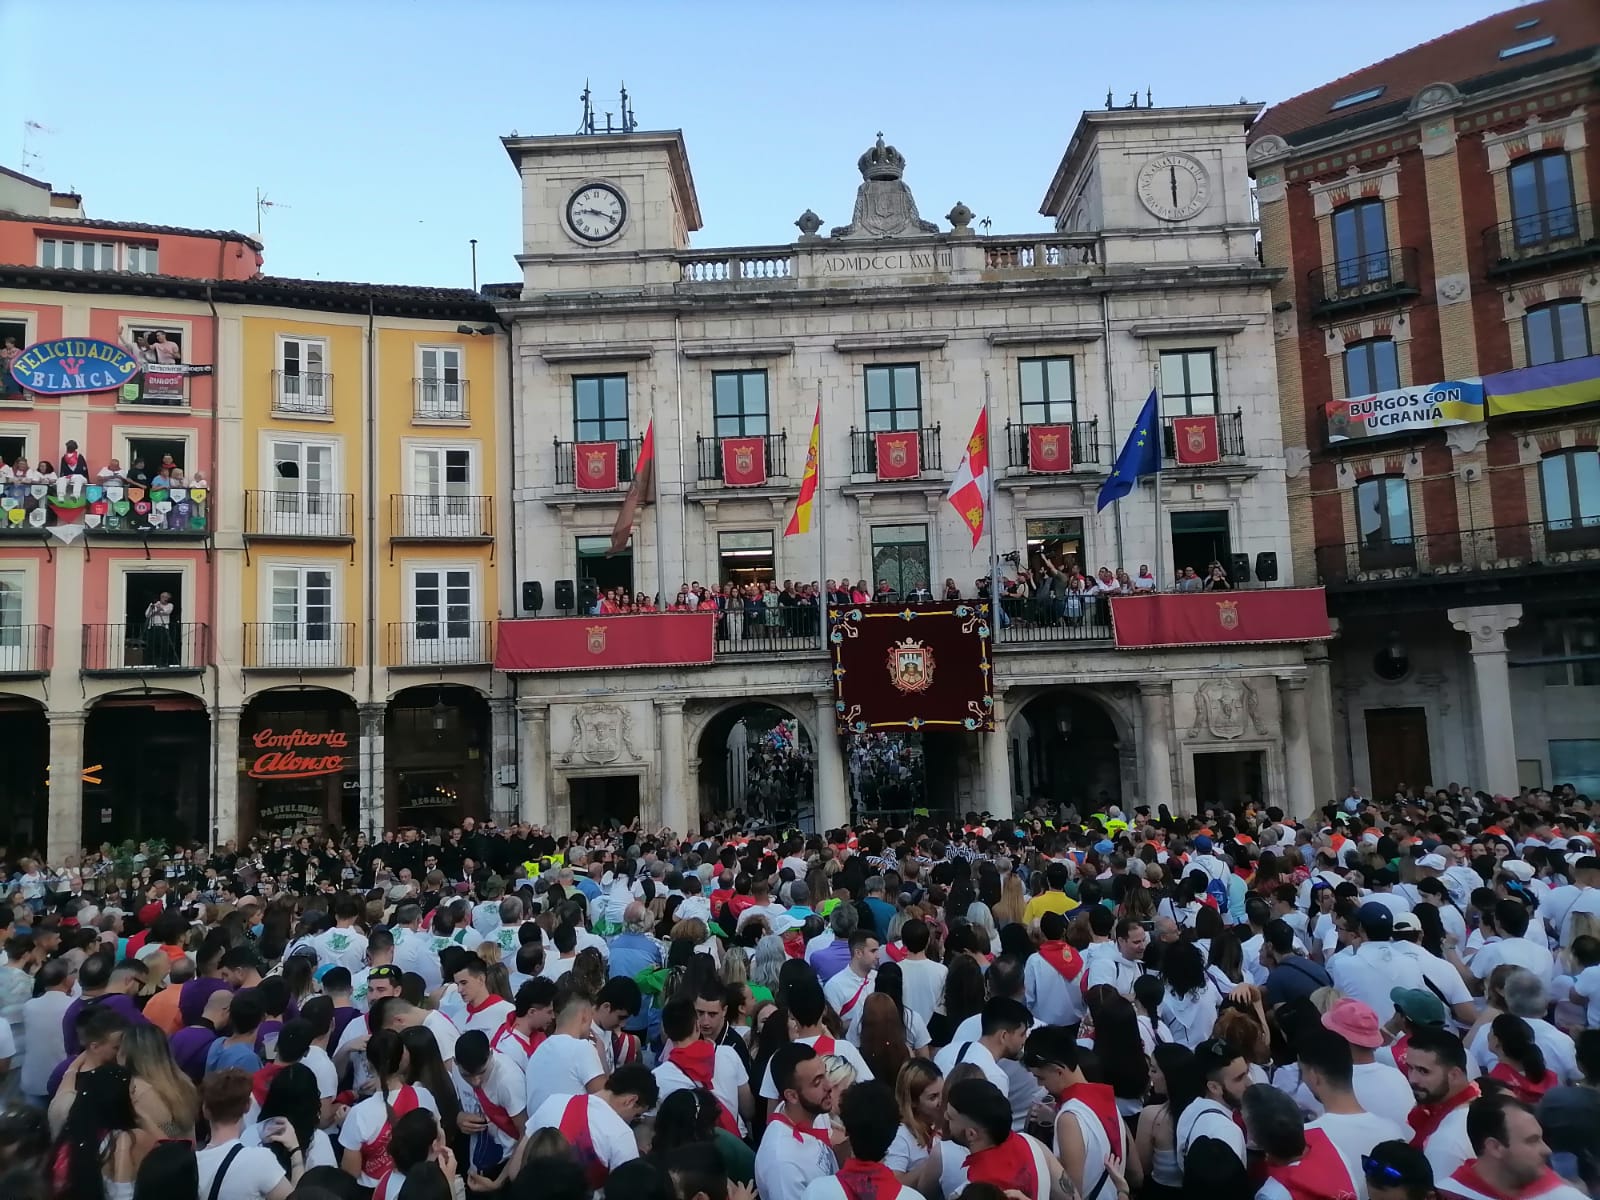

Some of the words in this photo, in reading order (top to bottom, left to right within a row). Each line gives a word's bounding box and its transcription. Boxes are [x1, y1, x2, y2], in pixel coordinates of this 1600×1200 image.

[14, 341, 136, 376] FELICIDADES
[31, 370, 117, 389] BLANCA
[1350, 394, 1419, 416] BURGOS
[1423, 388, 1461, 404] CON
[1367, 407, 1443, 429] UCRANIA
[253, 751, 345, 773] Alonso
